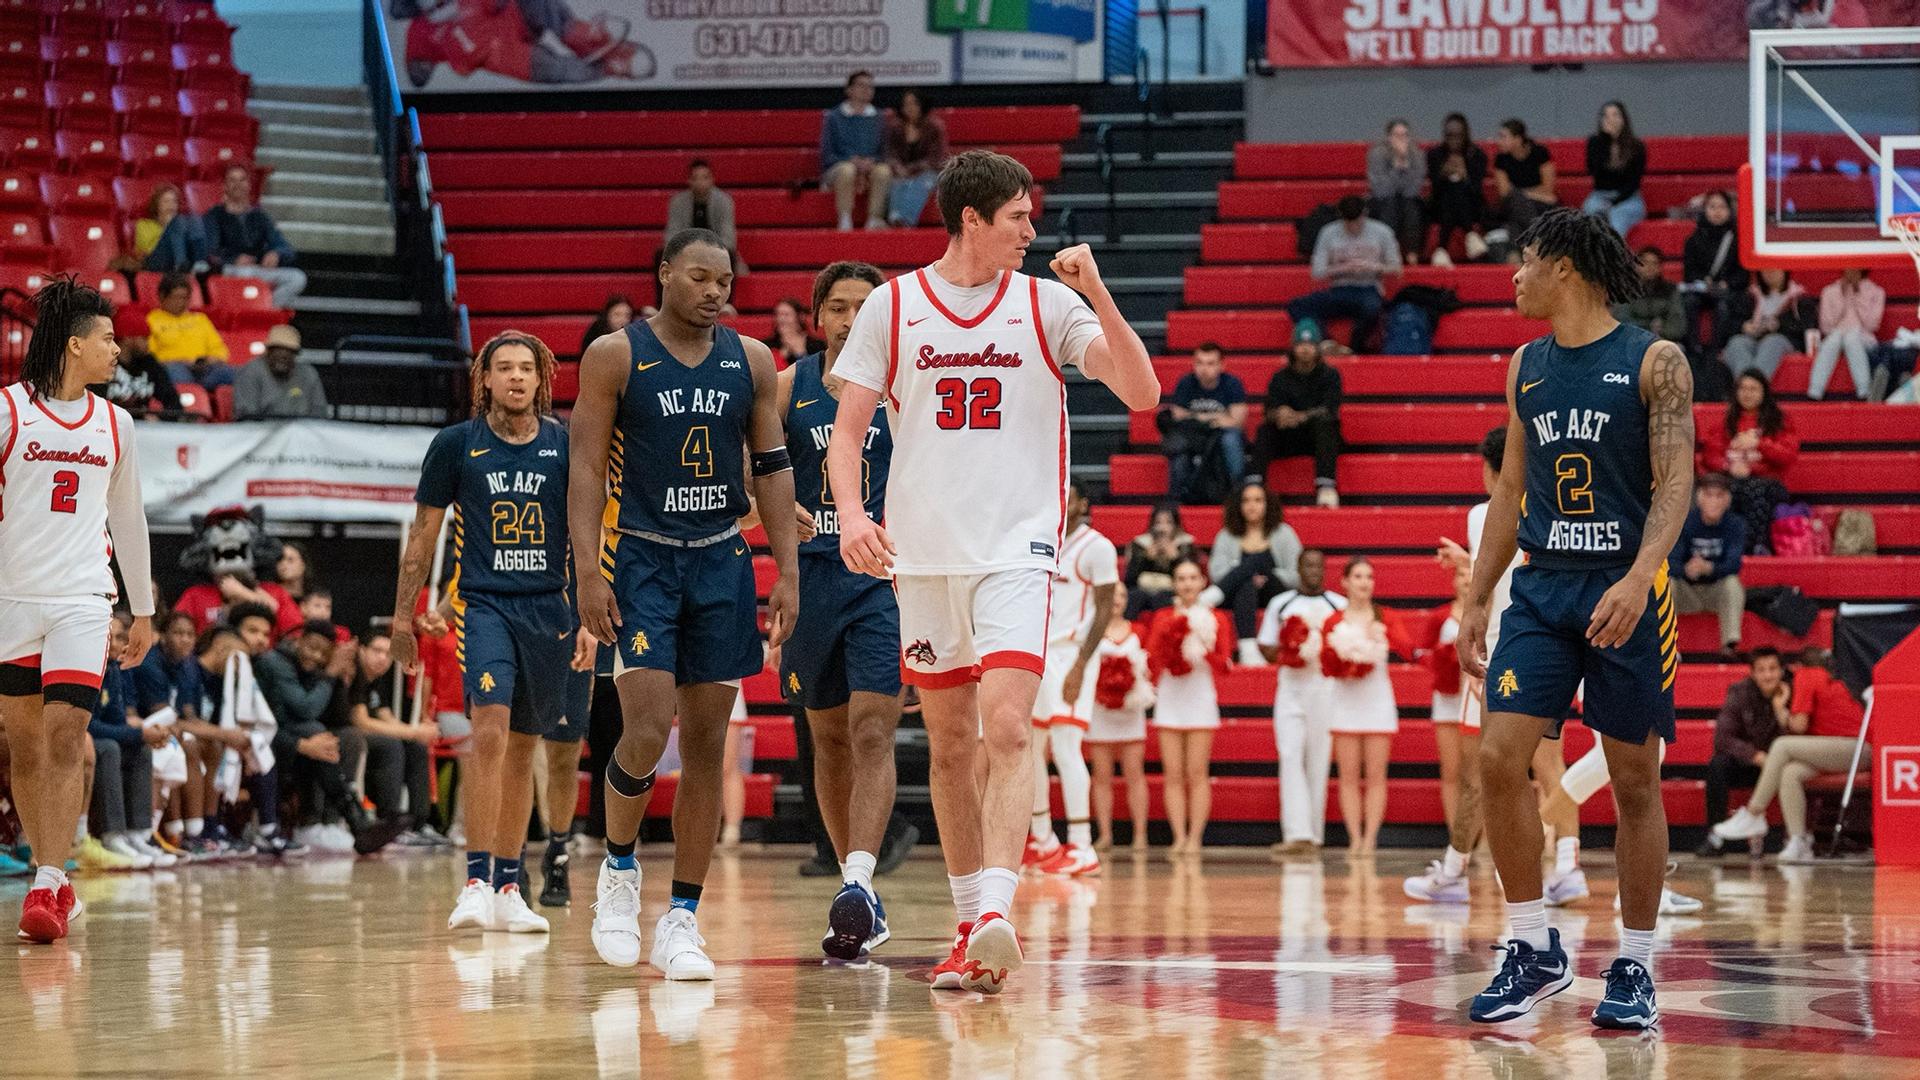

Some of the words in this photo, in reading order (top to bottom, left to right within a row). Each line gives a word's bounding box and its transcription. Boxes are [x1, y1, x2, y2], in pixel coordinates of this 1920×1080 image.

[694, 22, 889, 57] 631-471-8000
[1345, 31, 1415, 61] WE'LL
[1423, 28, 1500, 59] BUILD
[1509, 26, 1535, 57] IT
[1543, 25, 1614, 55] BACK
[1622, 22, 1666, 54] UP.
[720, 360, 742, 369] CAA
[916, 343, 1023, 370] Seawolves
[1603, 372, 1630, 384] CAA
[657, 388, 686, 417] NC
[691, 387, 730, 417] A&T
[936, 377, 1002, 430] 32
[1532, 410, 1561, 446] NC
[1566, 408, 1611, 443] A&T
[23, 441, 108, 467] Seawolves
[538, 449, 558, 457] CAA
[681, 426, 713, 478] 4
[51, 470, 80, 514] 2
[486, 471, 510, 495] NC
[513, 471, 547, 495] A&T
[663, 484, 728, 512] AGGIES
[1555, 453, 1595, 515] 2
[491, 501, 545, 545] 24
[1547, 520, 1622, 551] AGGIES
[493, 549, 547, 571] AGGIES
